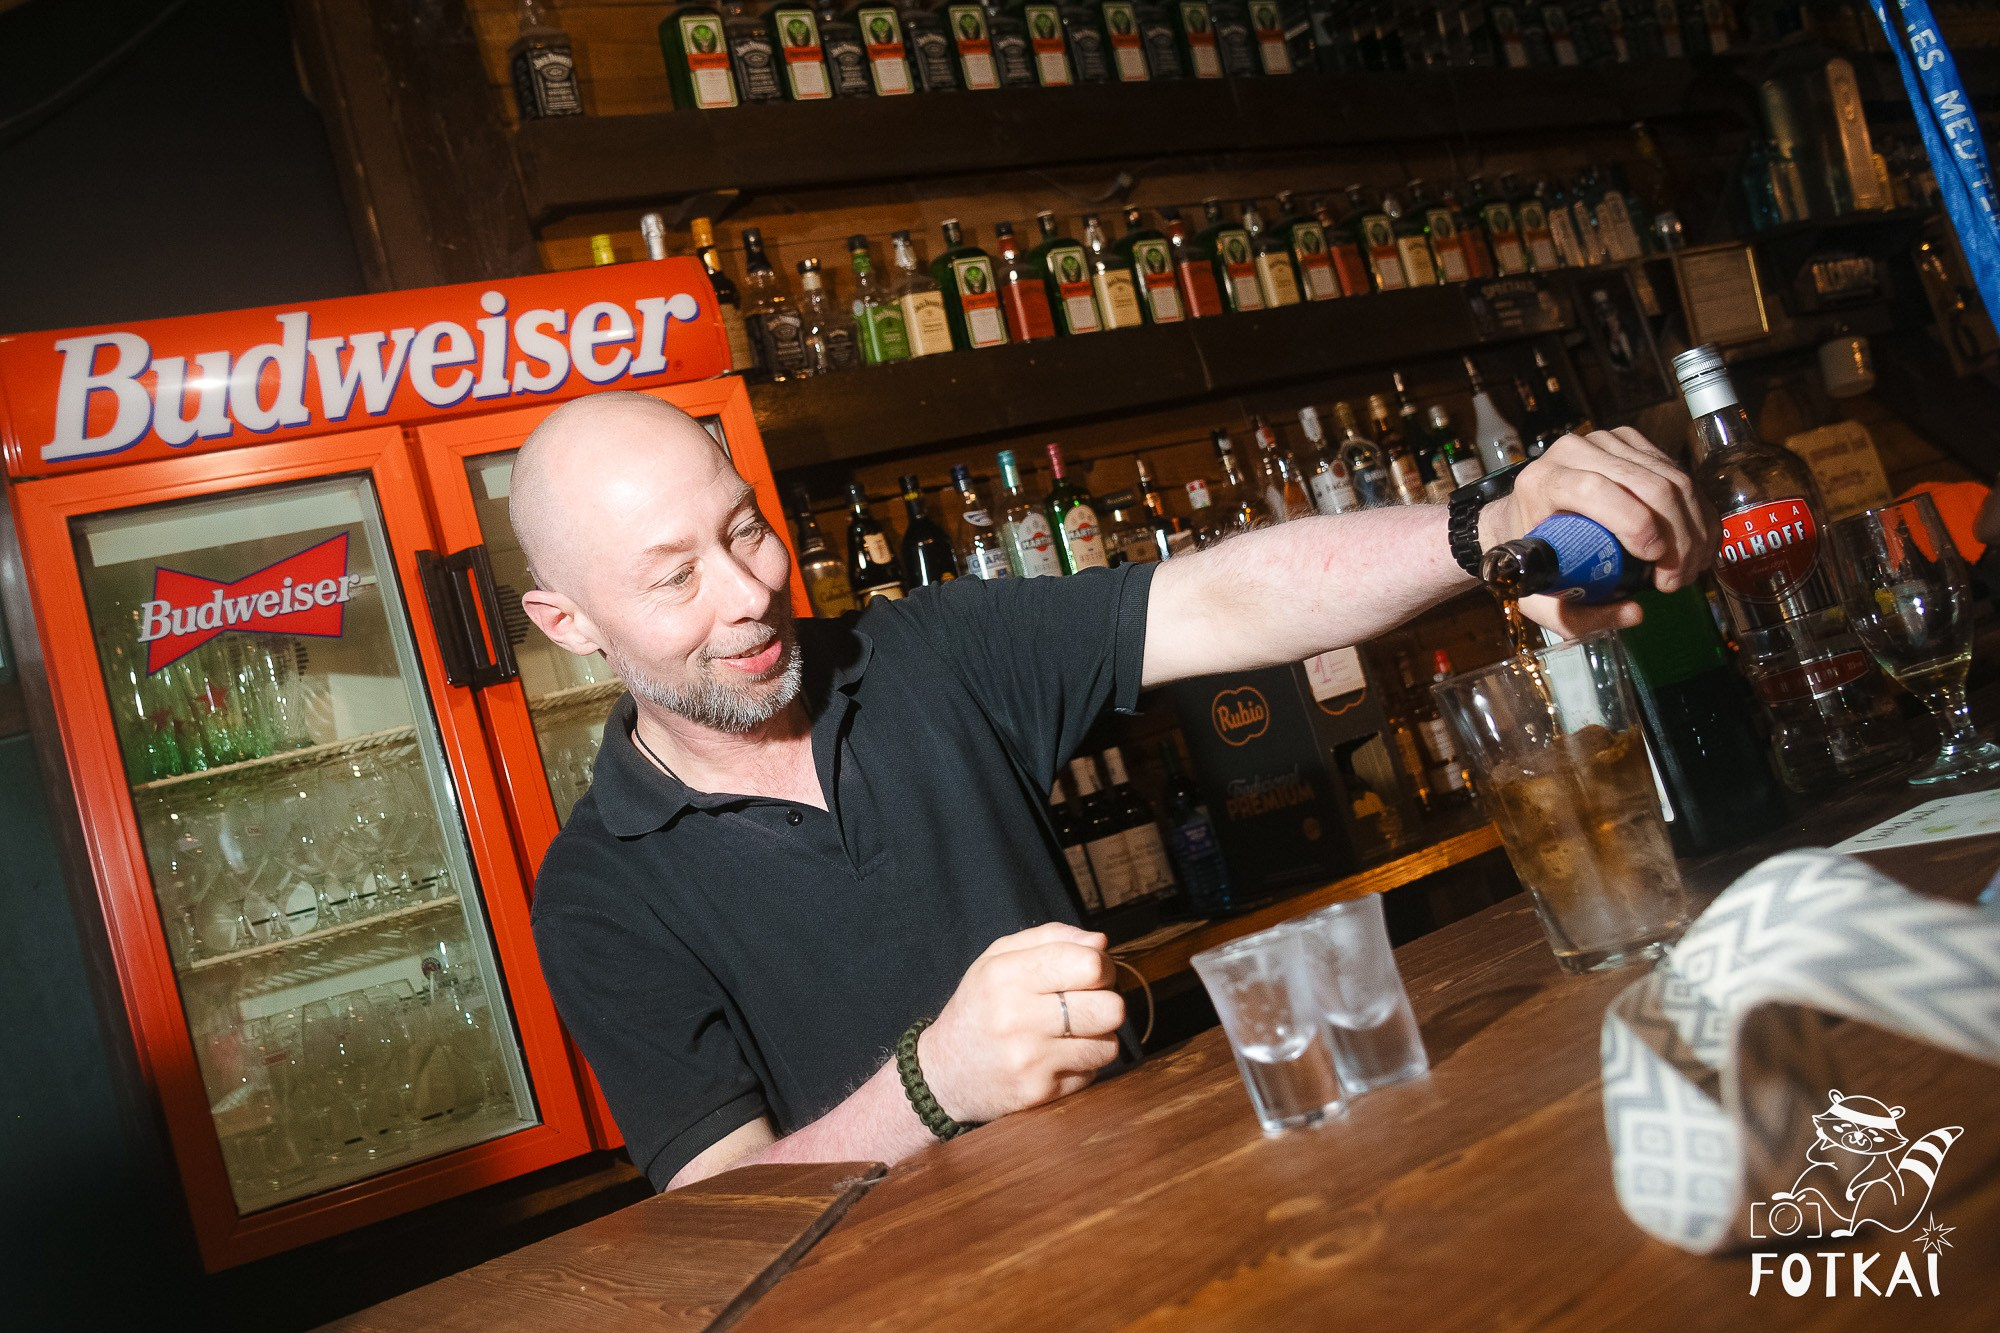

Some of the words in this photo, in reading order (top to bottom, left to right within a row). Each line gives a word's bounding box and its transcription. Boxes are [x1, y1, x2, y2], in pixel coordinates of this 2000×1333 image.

[41, 291, 698, 463] Budweiser
[1718, 520, 1805, 566] OLKOFF
[1723, 505, 1800, 539] ODKA
[138, 574, 360, 642] Budweiser
[1217, 701, 1264, 732] Rubio
[1226, 782, 1315, 820] PREMIUM
